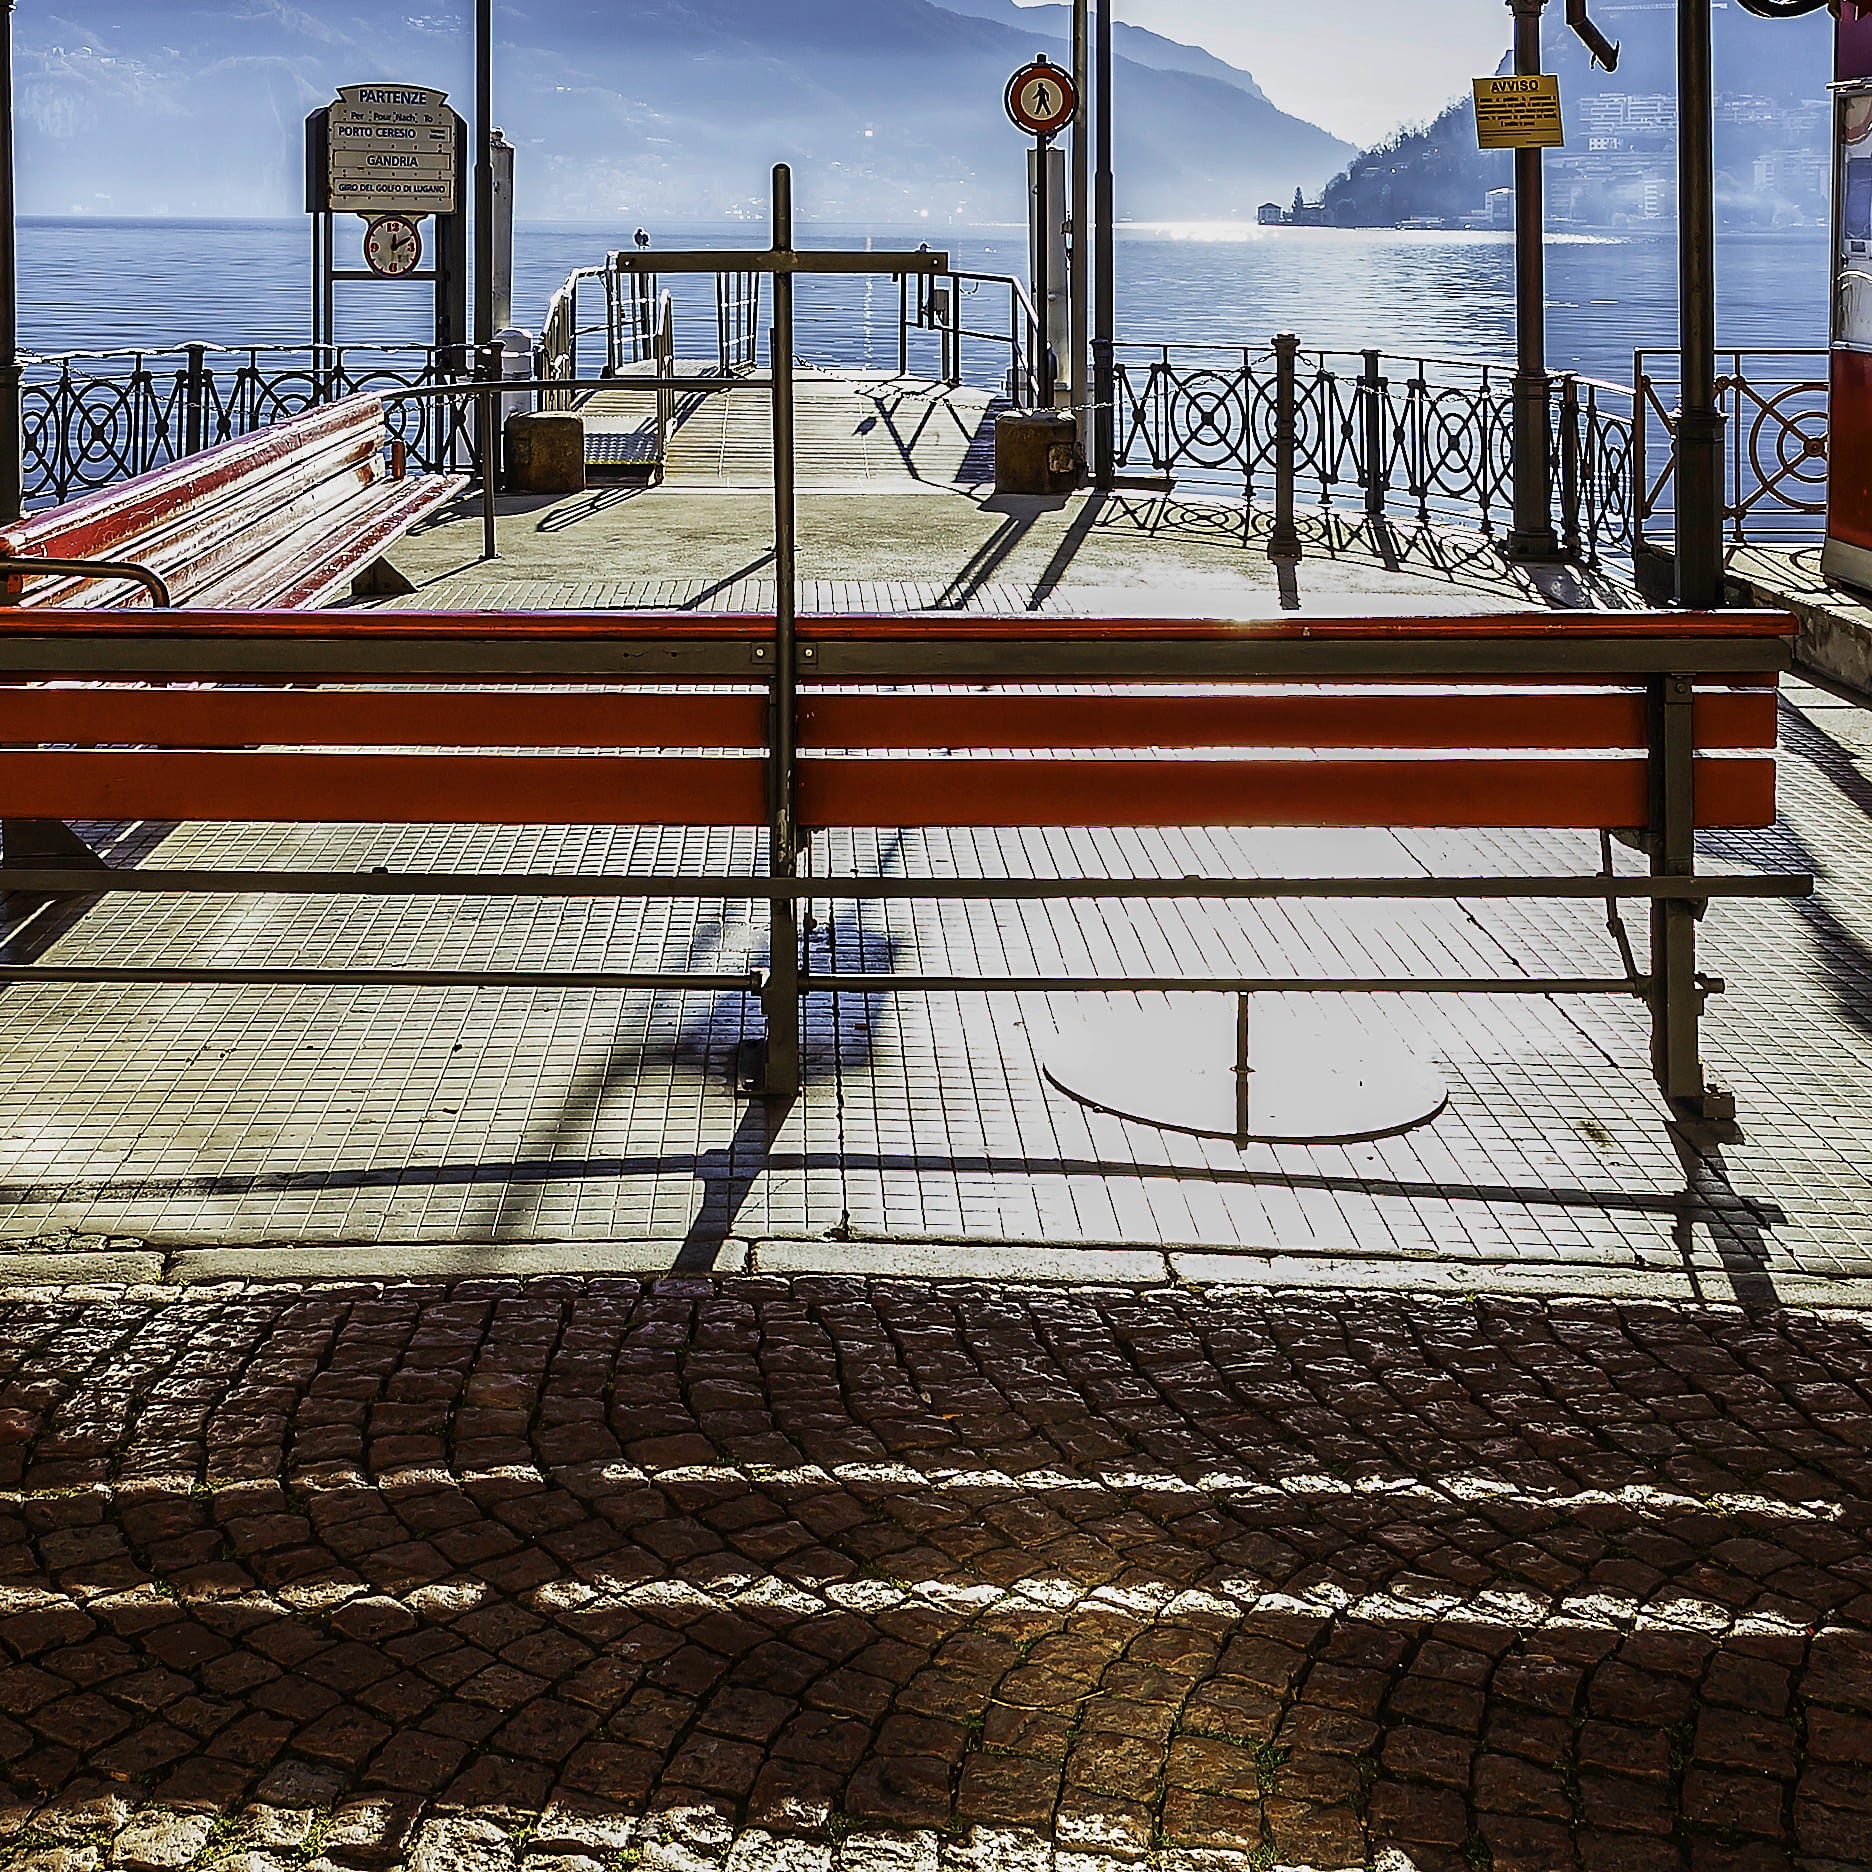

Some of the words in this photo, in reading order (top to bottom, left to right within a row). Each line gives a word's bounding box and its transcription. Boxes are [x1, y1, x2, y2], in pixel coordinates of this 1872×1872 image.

[1491, 80, 1539, 93] AVVISO
[359, 89, 427, 105] PARTENZE
[350, 111, 364, 120] Per
[373, 112, 391, 121] Pour
[423, 114, 433, 123] To
[338, 126, 373, 137] PORTO
[375, 127, 416, 138] CERESIO
[366, 155, 419, 167] GANDRIA
[338, 183, 359, 191] GIRO
[359, 184, 374, 192] DEL
[375, 184, 402, 192] GOLFO
[413, 185, 446, 194] LUGANO
[387, 223, 399, 232] 12
